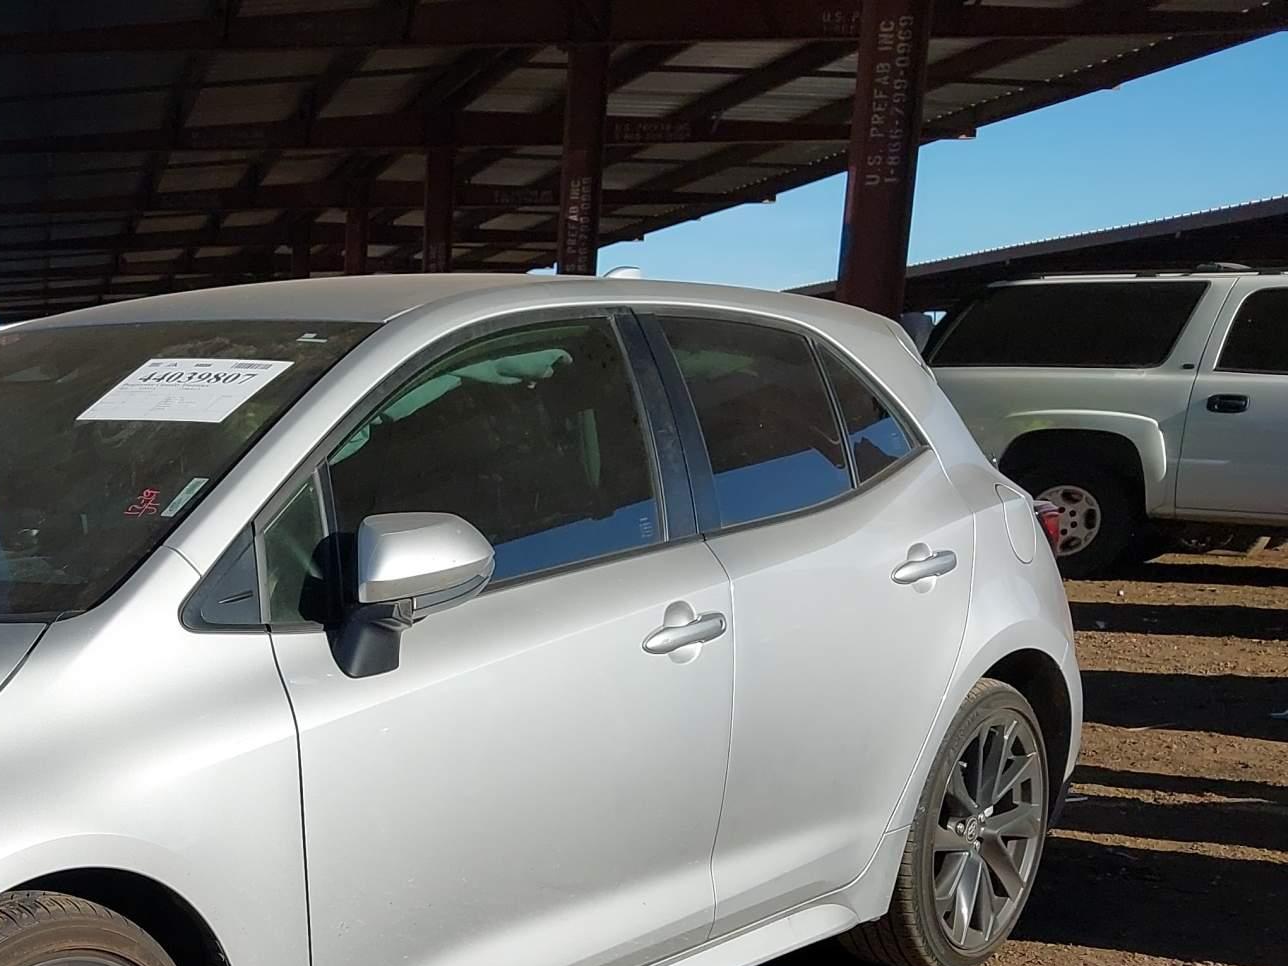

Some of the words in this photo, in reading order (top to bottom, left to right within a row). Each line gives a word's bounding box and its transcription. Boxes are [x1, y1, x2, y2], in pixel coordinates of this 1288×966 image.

[877, 19, 896, 51] INC
[869, 61, 892, 138] PREFAB
[138, 371, 258, 385] 44039807
